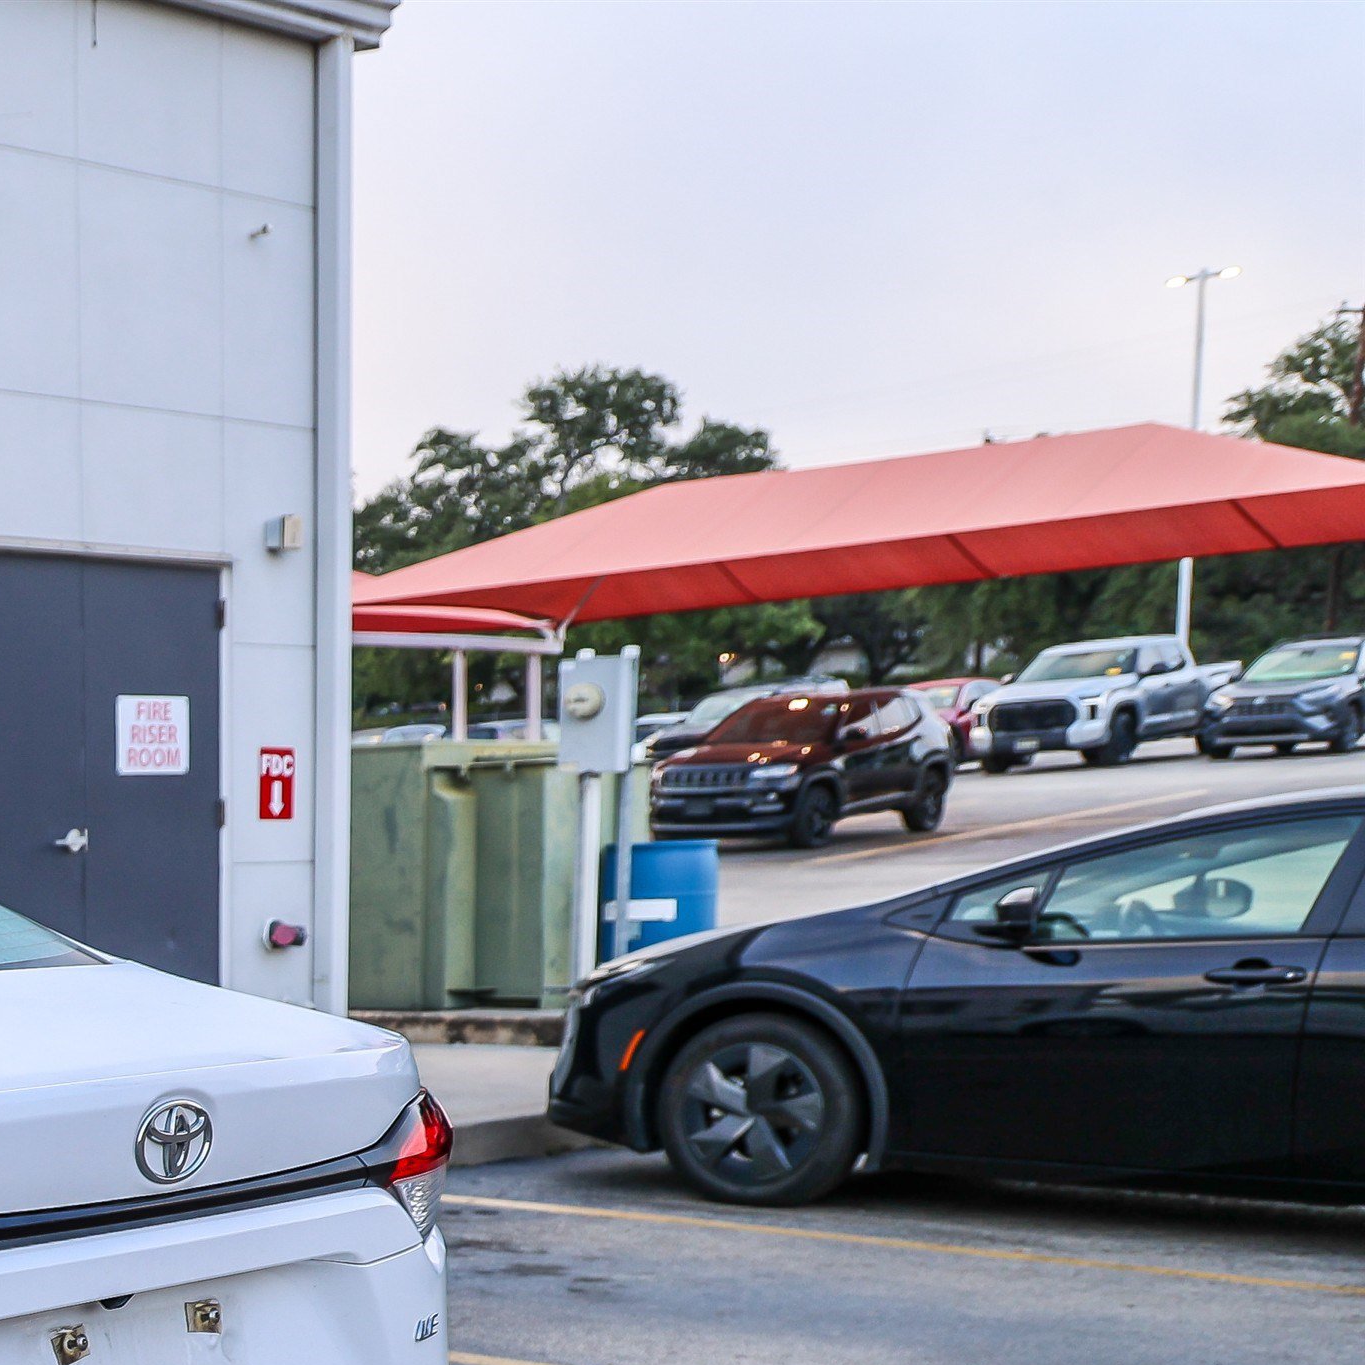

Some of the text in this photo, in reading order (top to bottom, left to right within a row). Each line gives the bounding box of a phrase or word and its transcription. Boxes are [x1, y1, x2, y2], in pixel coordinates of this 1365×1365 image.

[136, 701, 172, 721] FIRE
[131, 724, 178, 744] RISER
[128, 747, 180, 767] ROOM
[262, 753, 294, 777] FDC
